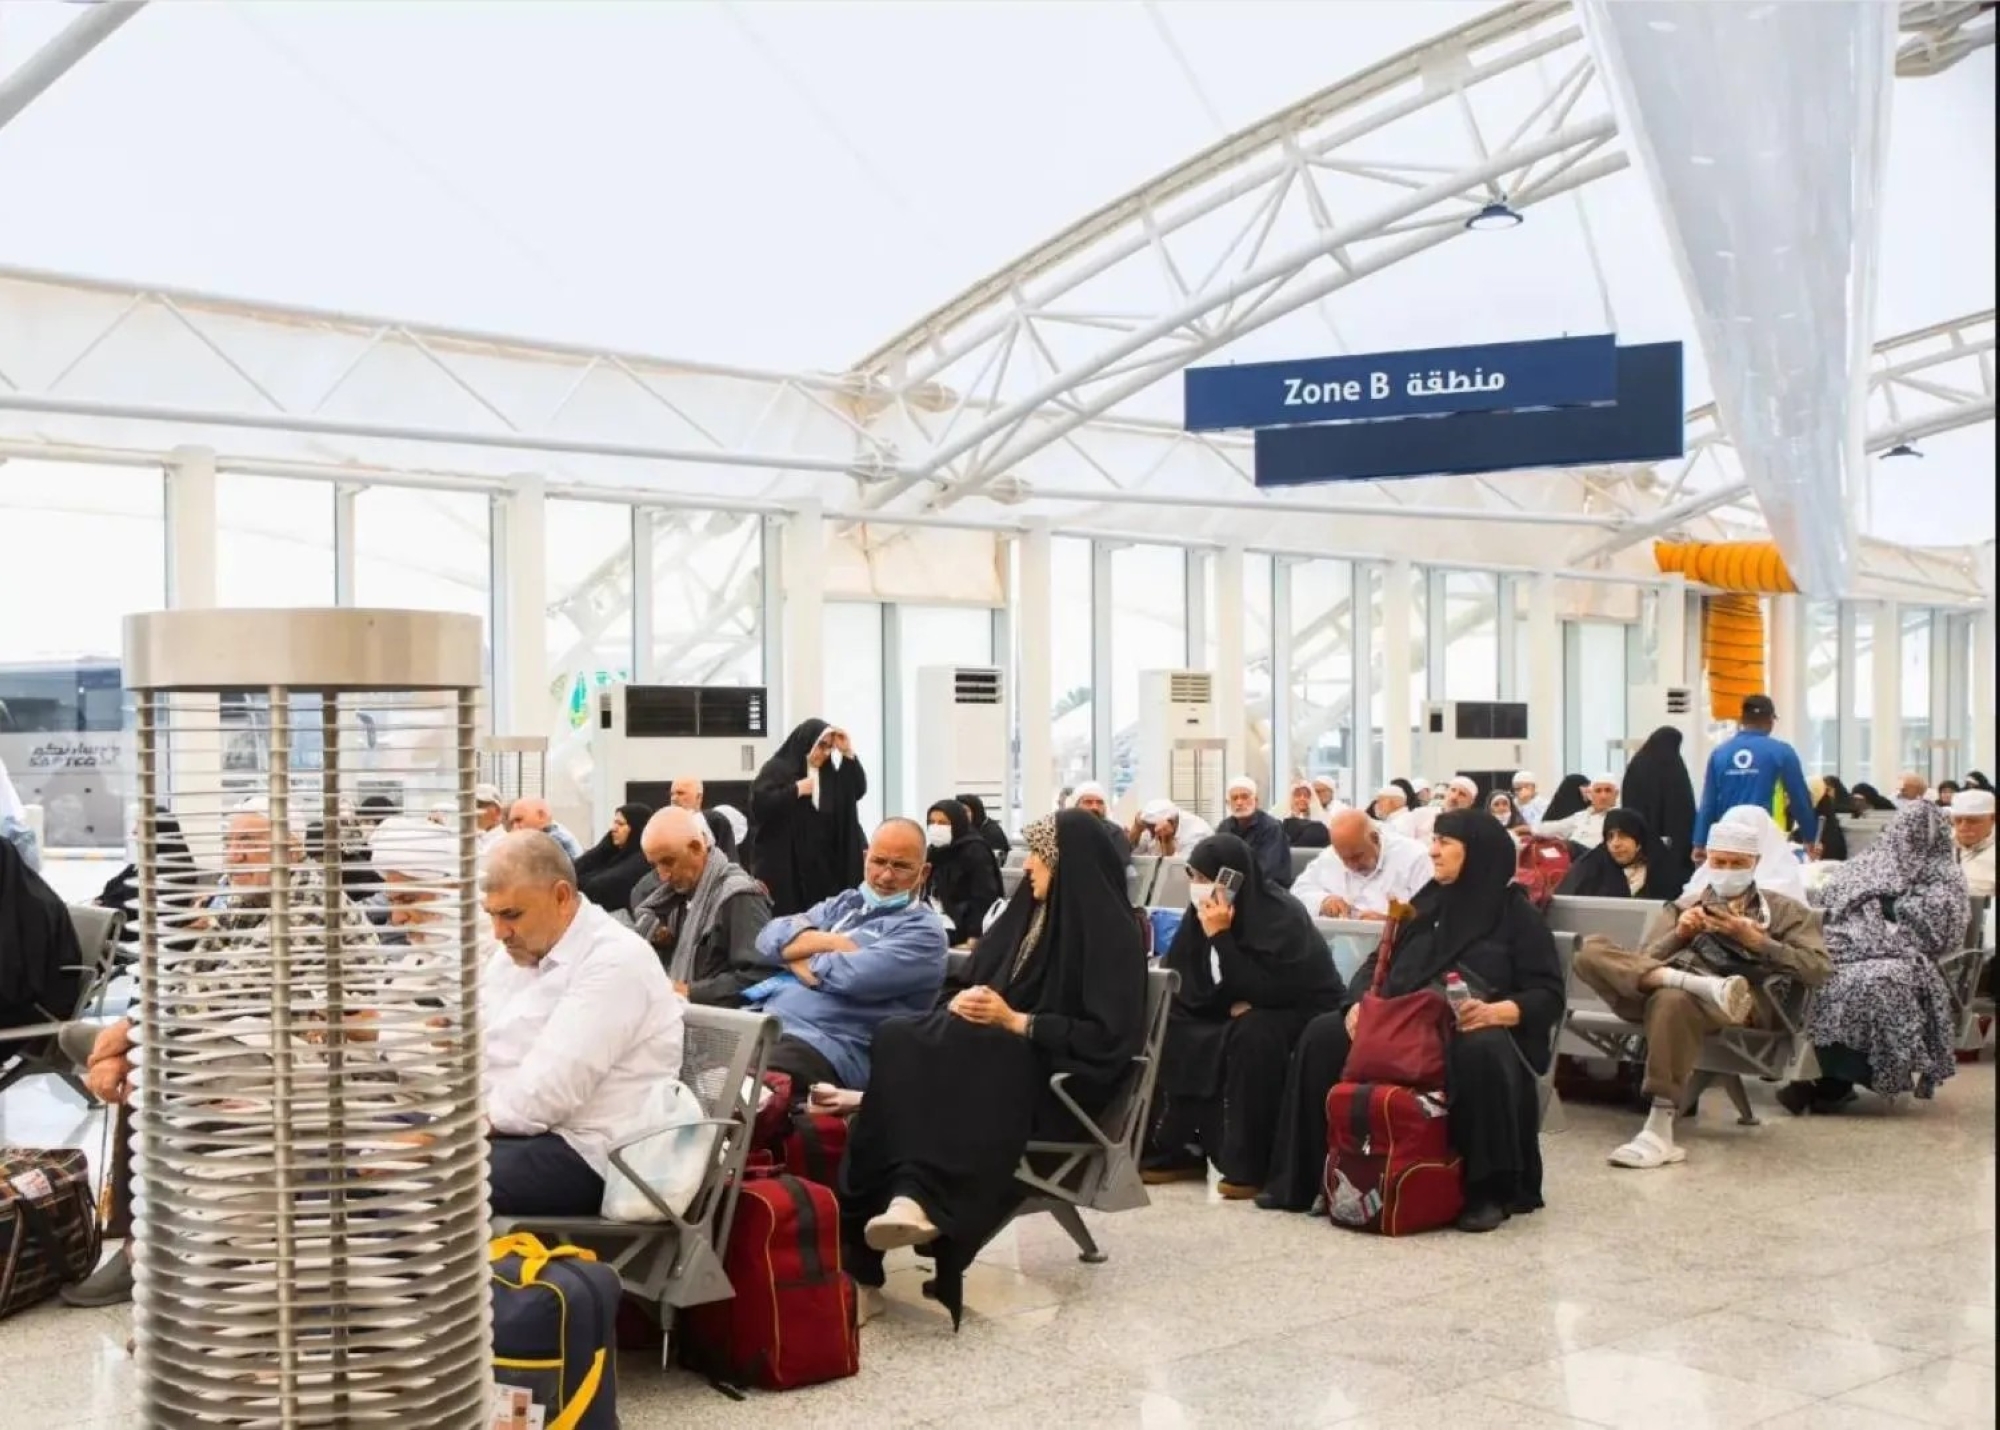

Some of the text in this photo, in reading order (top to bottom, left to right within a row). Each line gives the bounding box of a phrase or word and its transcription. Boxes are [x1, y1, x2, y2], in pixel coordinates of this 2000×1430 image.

[1283, 367, 1505, 405] Zone B منطقة
